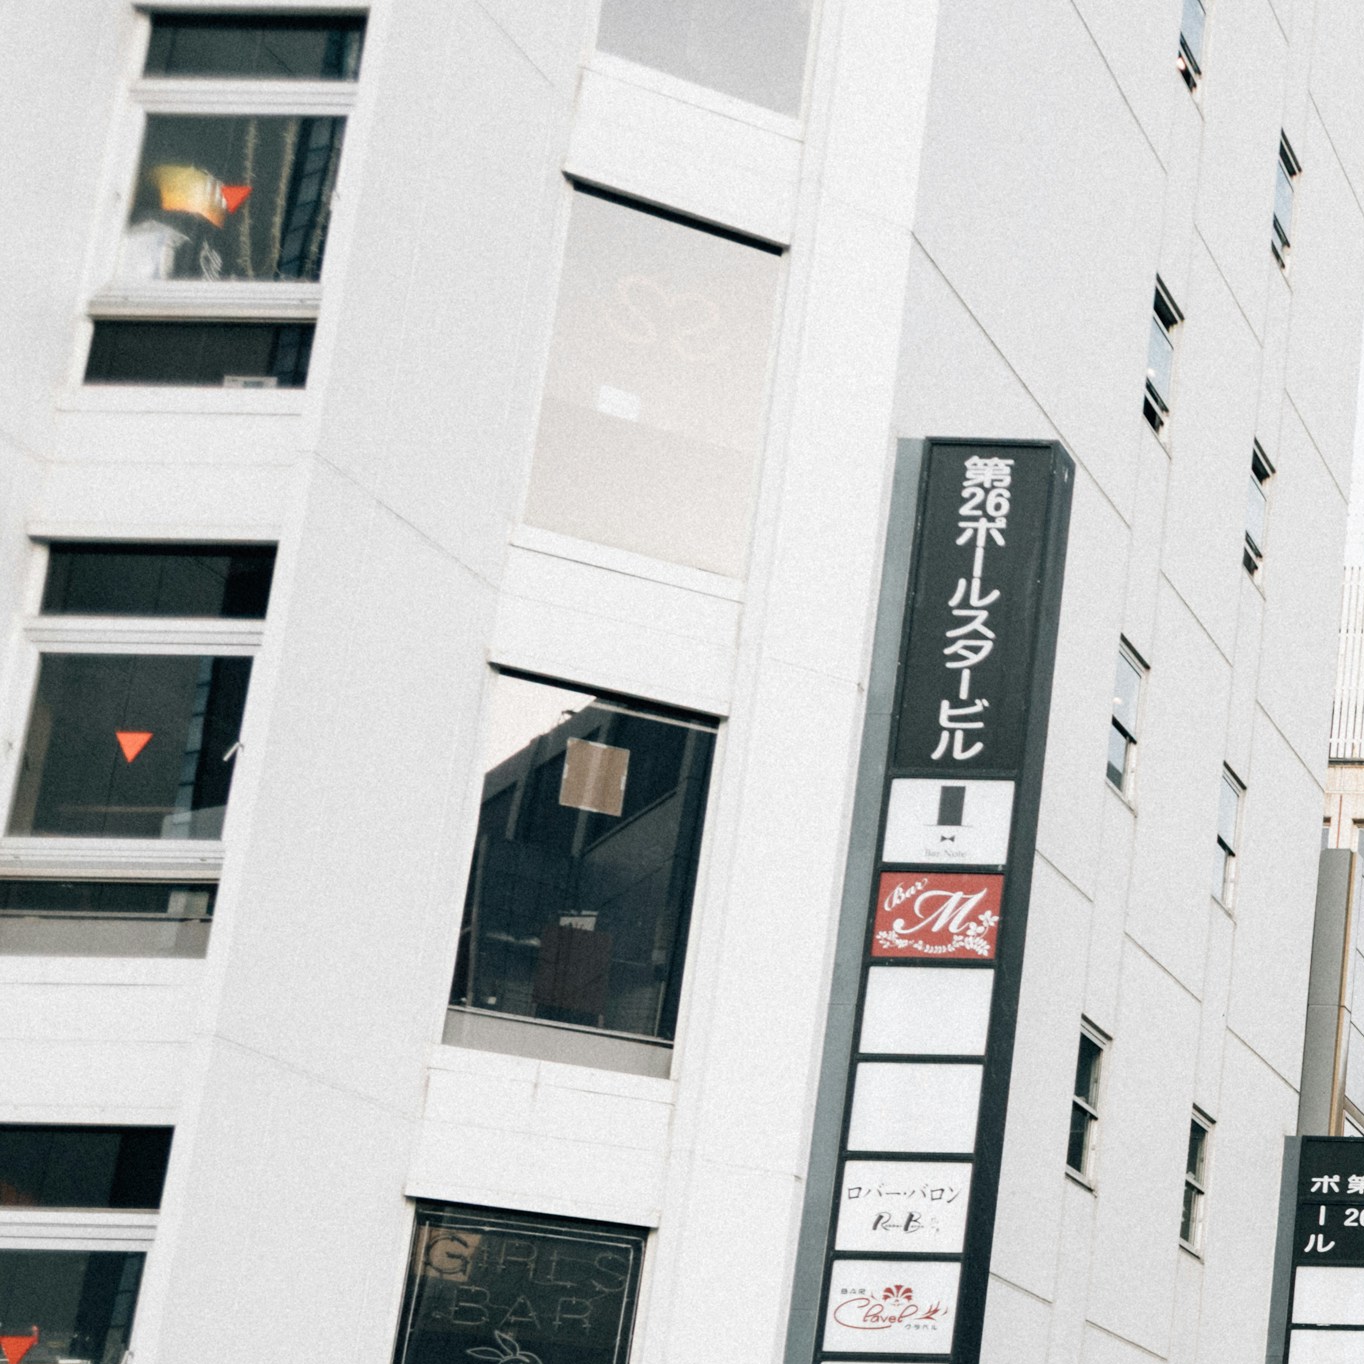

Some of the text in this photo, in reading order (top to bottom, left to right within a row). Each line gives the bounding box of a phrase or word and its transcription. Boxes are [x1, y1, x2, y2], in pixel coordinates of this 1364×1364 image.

[930, 454, 1015, 762] 第26ポールスタービル
[883, 878, 928, 912] Bar
[840, 1287, 867, 1296] BAR
[833, 1297, 919, 1330] Clavel
